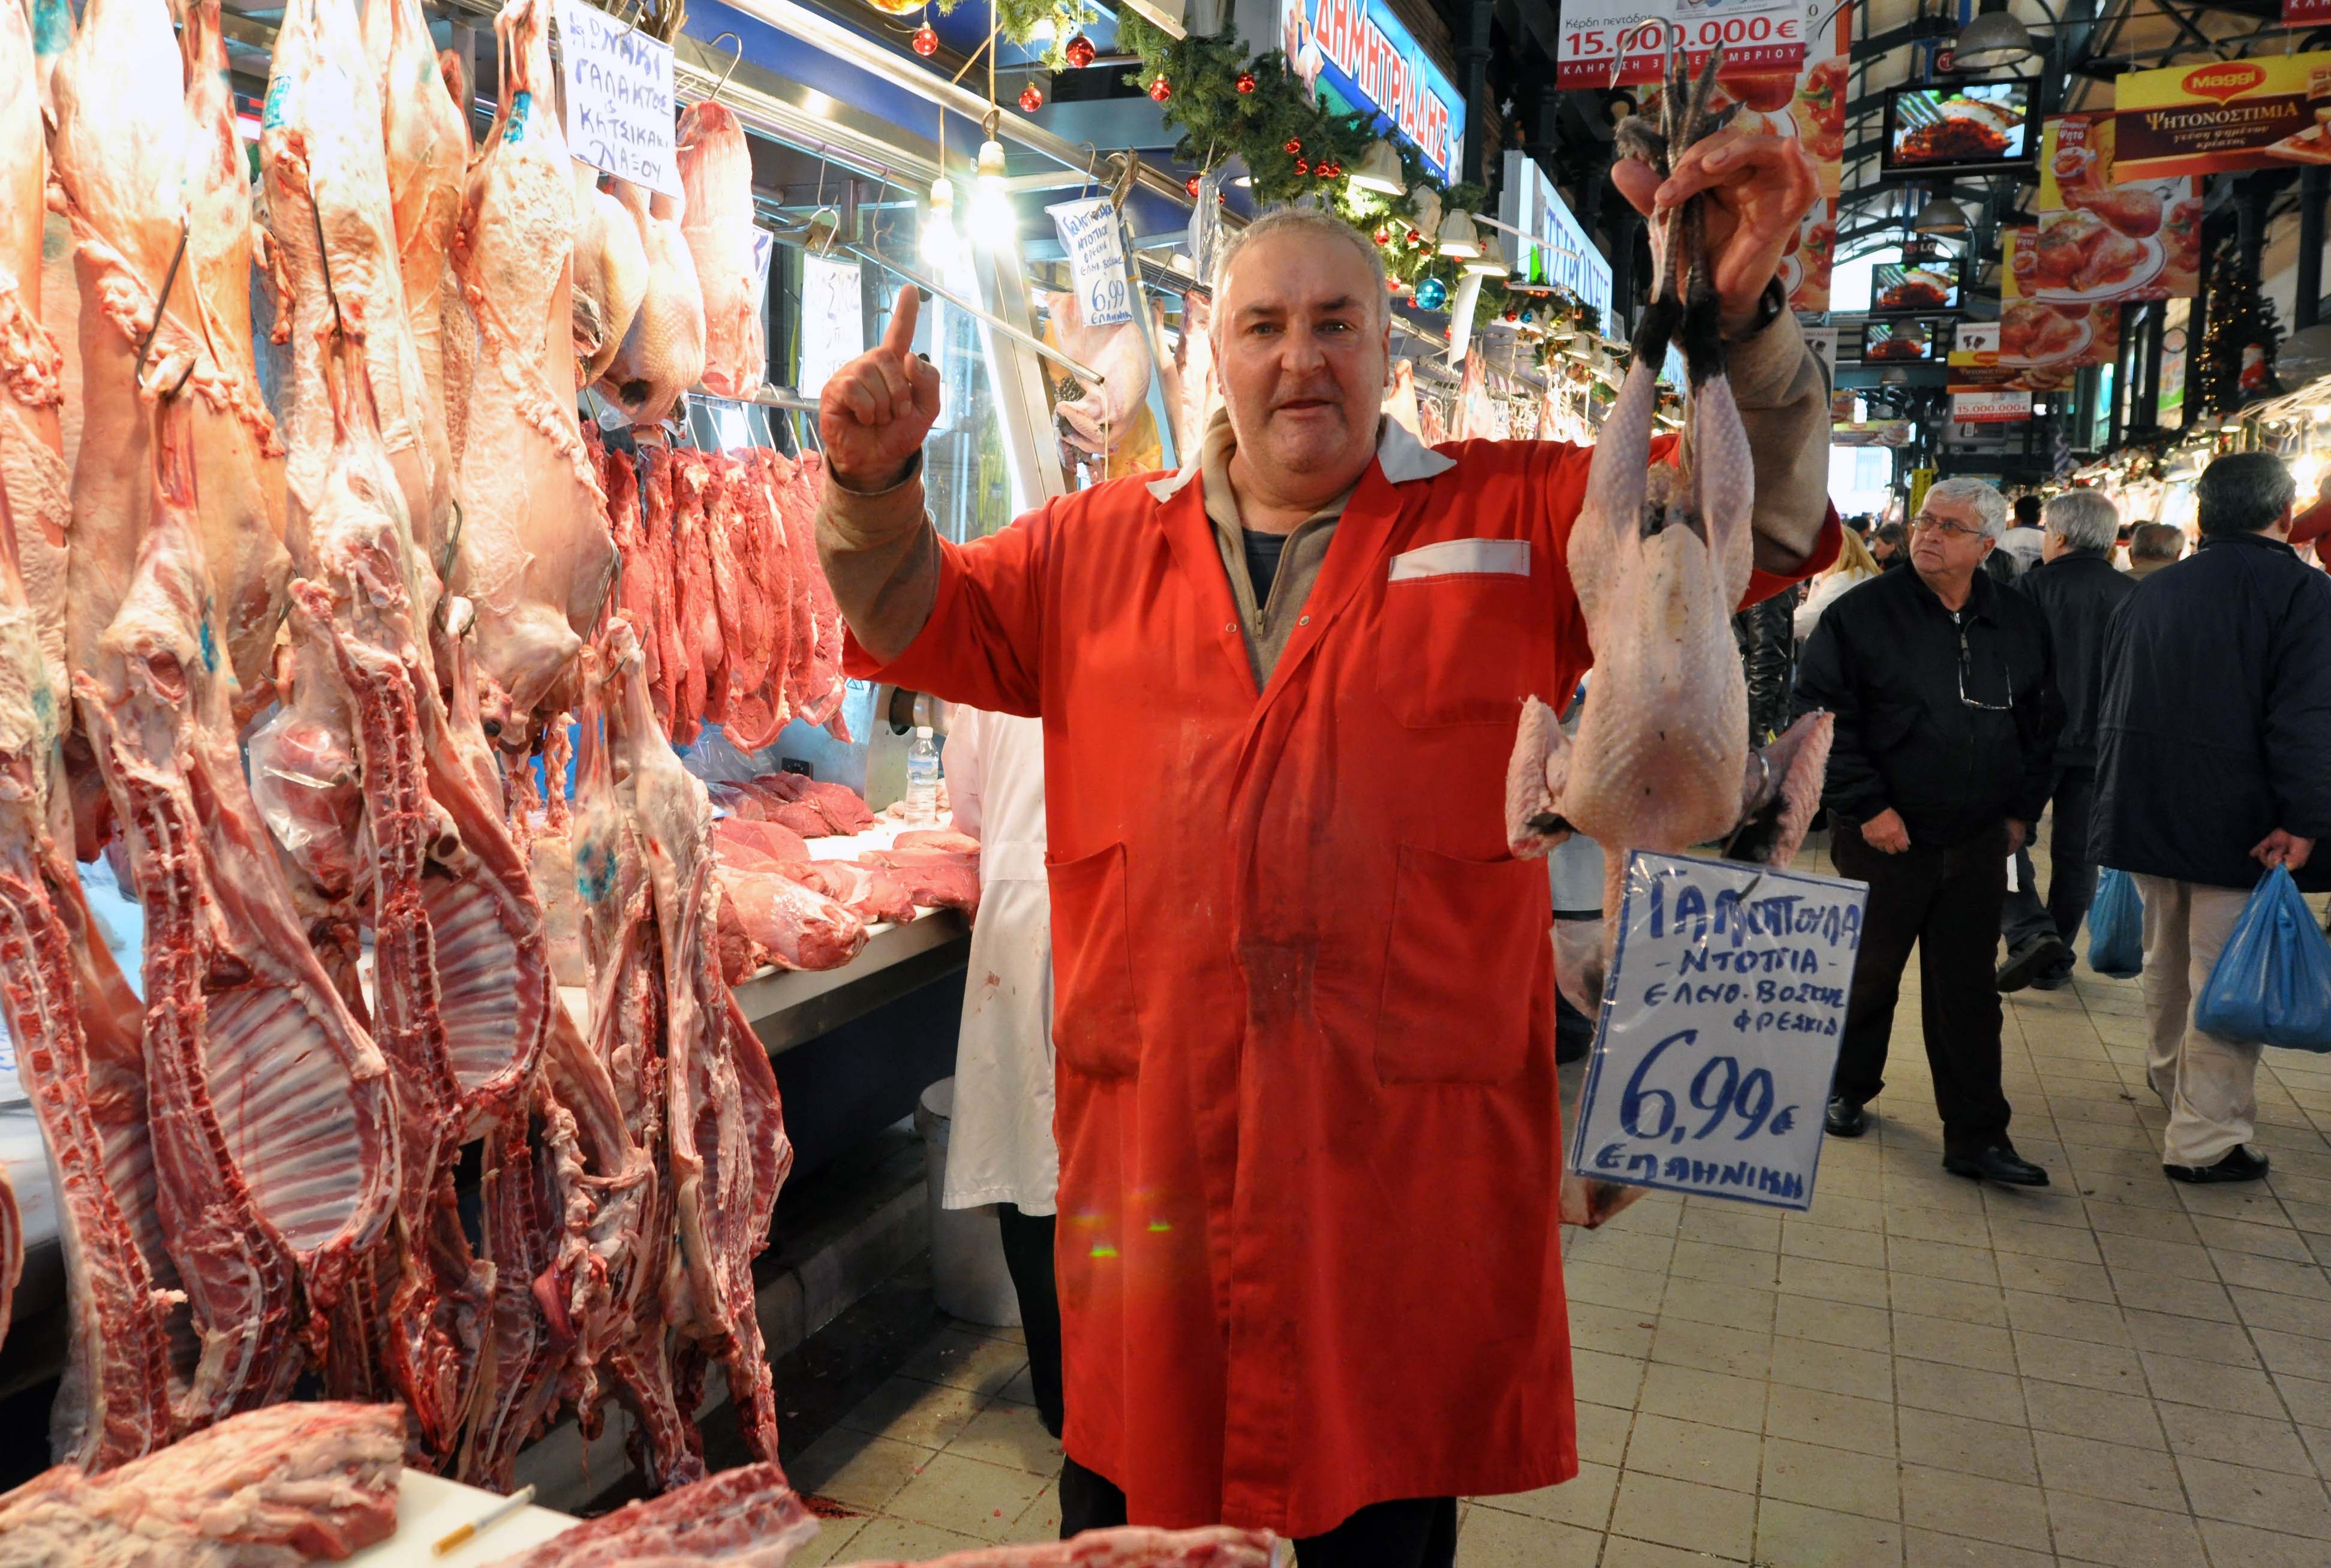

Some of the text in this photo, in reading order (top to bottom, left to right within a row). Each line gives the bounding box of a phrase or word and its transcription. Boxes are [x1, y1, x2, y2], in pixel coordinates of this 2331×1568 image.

[1566, 18, 1599, 31] Κέρδη
[1313, 0, 1449, 172] ΔΗΜΗΤΡΙΑΔΗΣ
[2192, 68, 2254, 89] Maggi
[1092, 279, 1125, 312] 6,99
